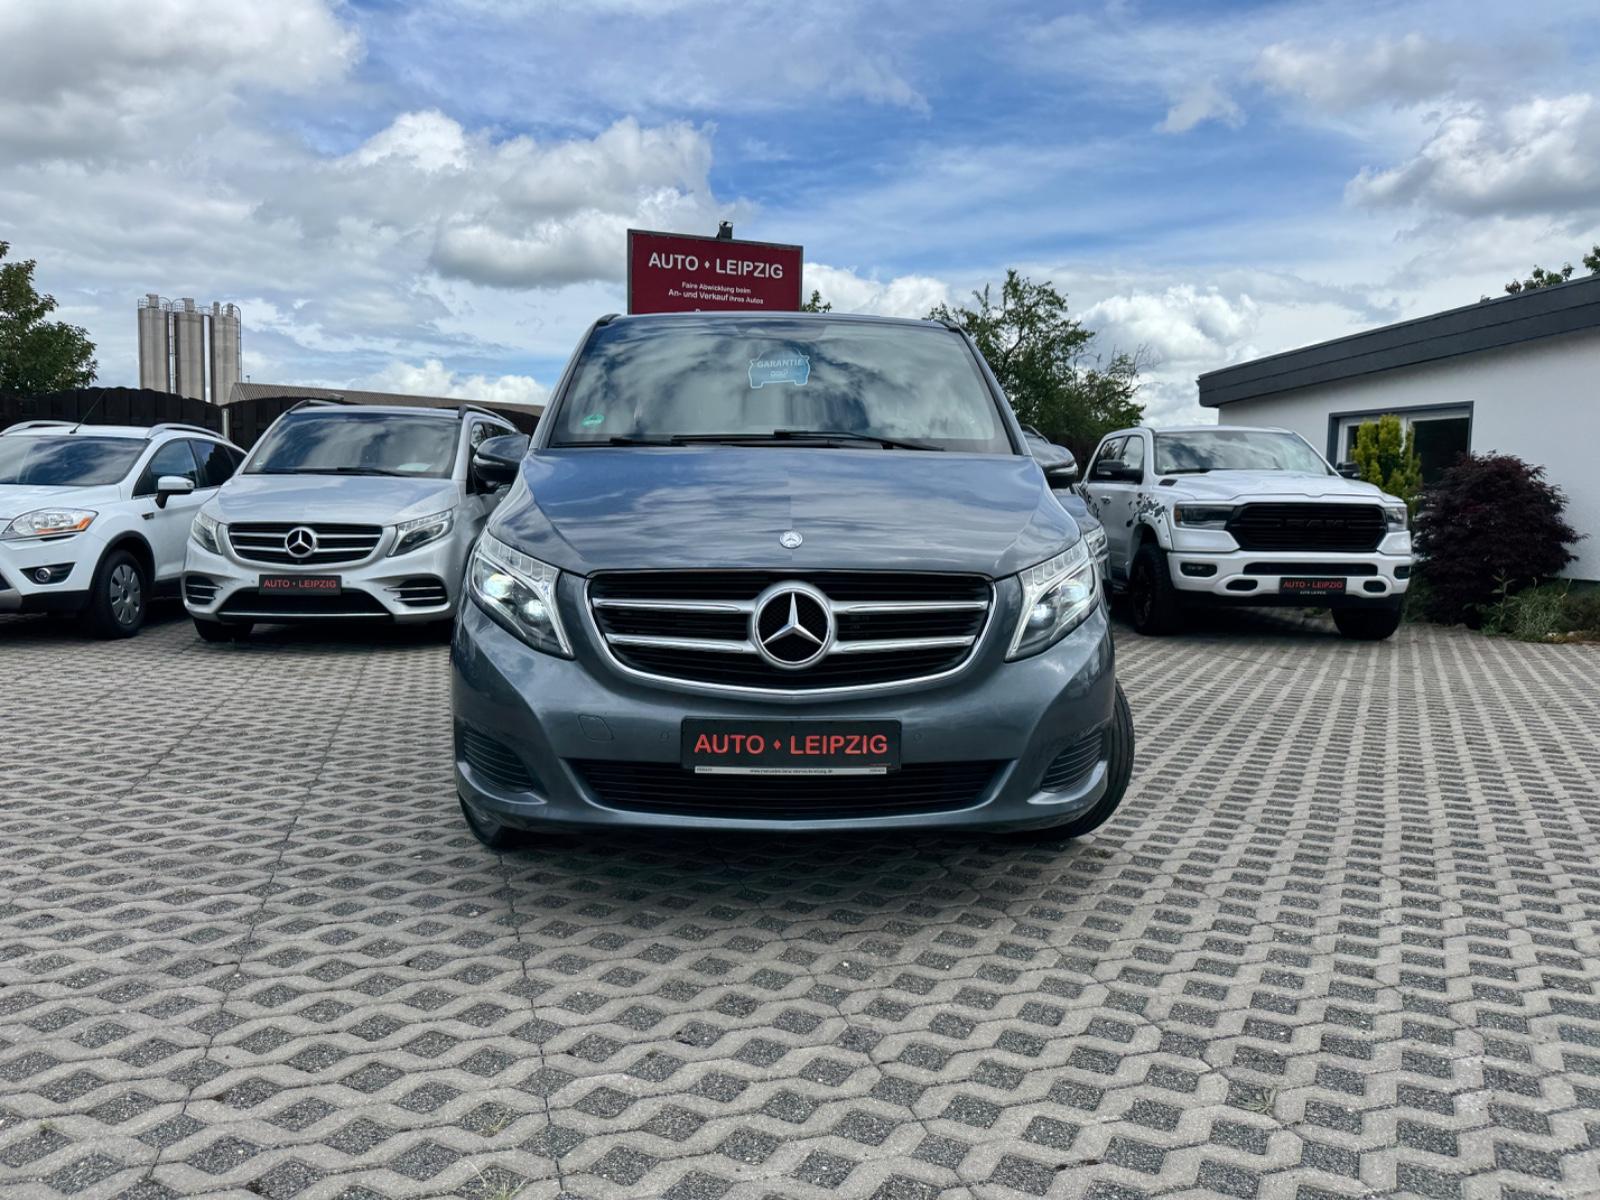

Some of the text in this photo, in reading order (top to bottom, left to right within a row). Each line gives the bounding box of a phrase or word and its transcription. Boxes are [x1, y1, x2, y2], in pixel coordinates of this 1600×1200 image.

[648, 252, 783, 279] AUTO LEIPZIG
[681, 281, 698, 289] Faire
[699, 283, 735, 293] Abwicklung
[683, 290, 698, 298] und
[699, 291, 728, 301] Verkauf
[757, 359, 802, 368] GARANTIE
[263, 579, 337, 589] AUTO LEIPZIG
[1283, 580, 1306, 588] AUTO
[693, 734, 888, 755] AUTO LEIPZIG
